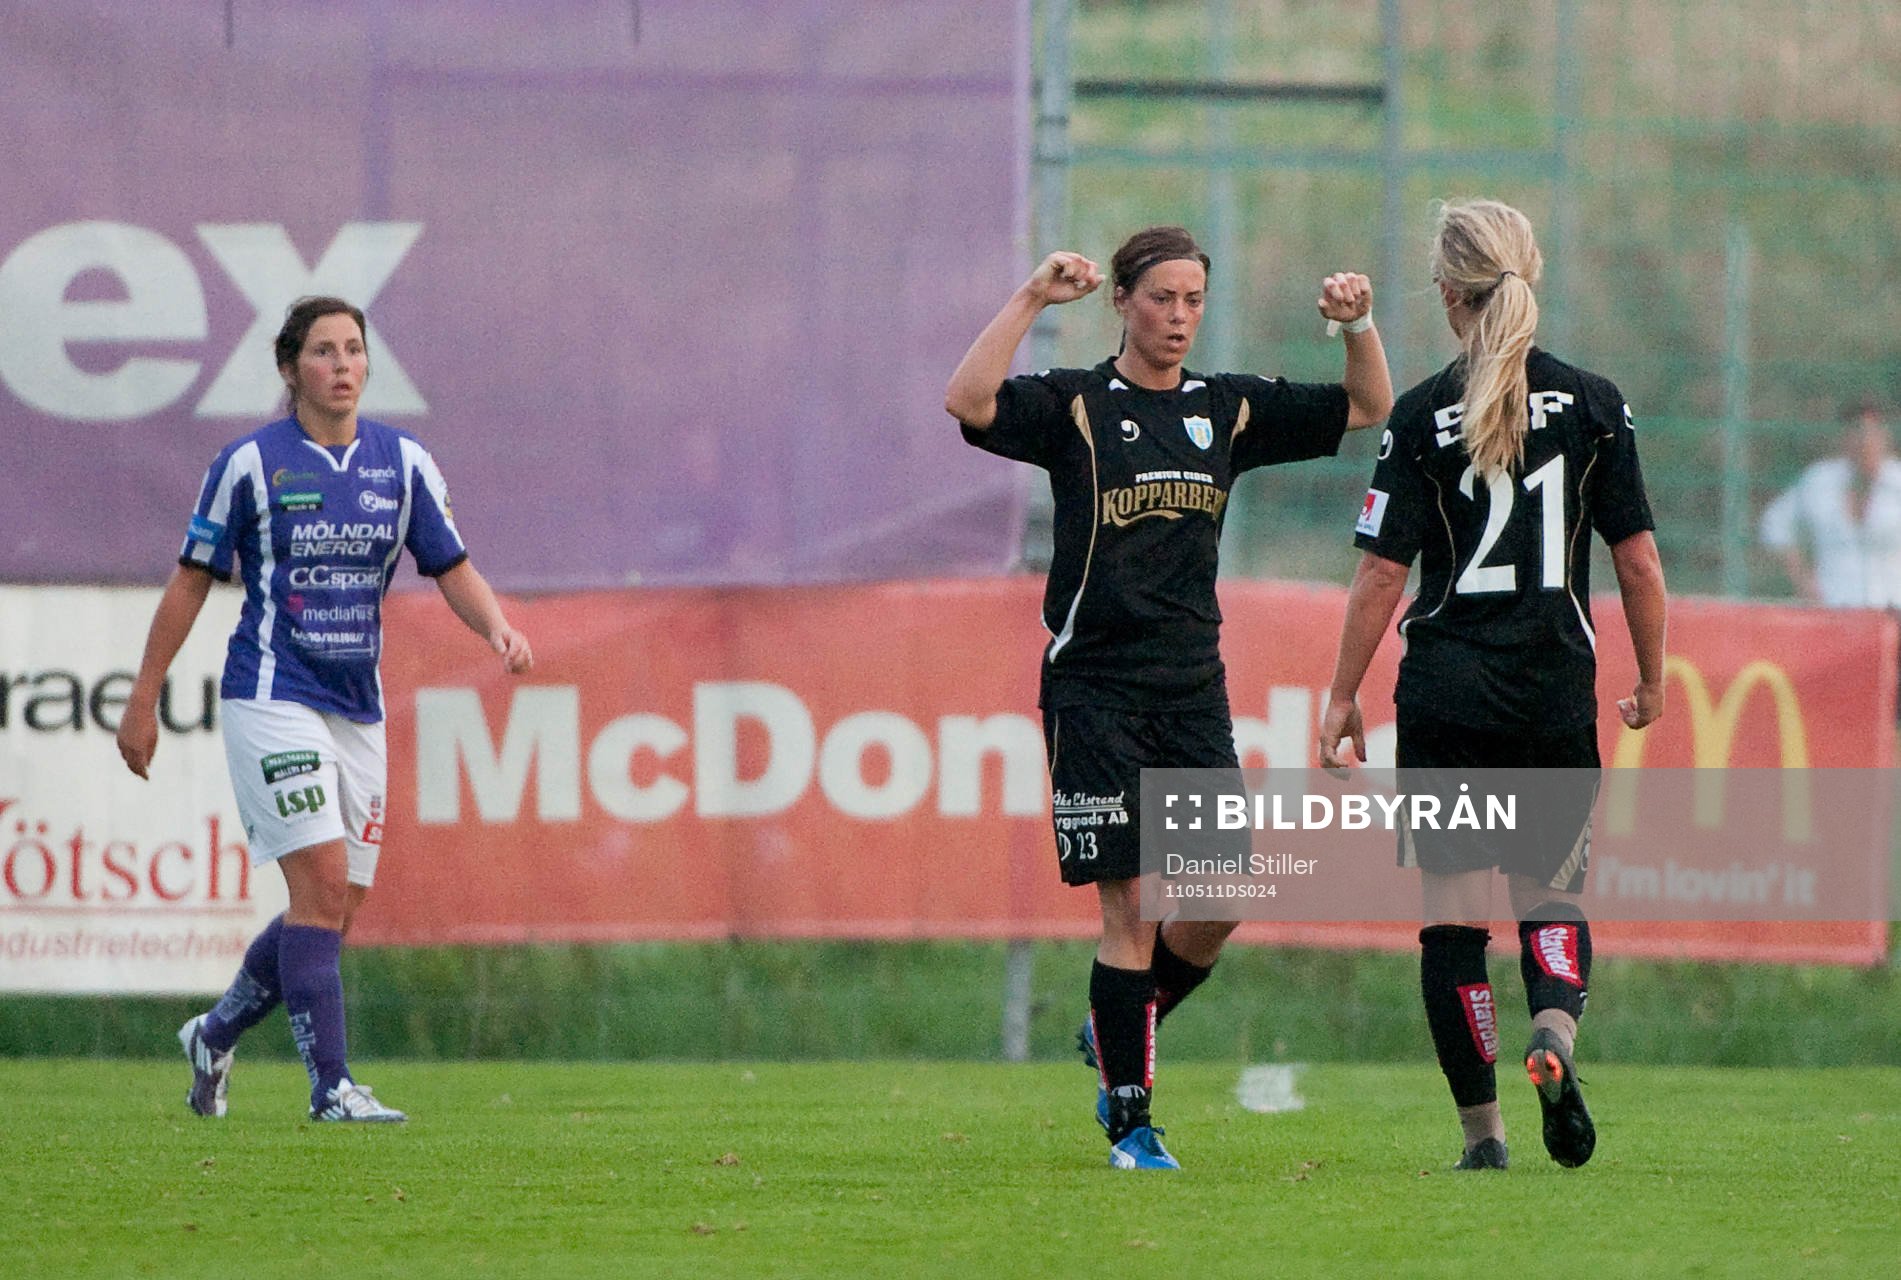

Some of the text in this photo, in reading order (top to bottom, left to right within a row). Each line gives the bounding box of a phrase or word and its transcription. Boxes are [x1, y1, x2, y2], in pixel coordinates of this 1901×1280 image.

[0, 220, 429, 422] ex
[1434, 390, 1575, 449] SF
[1135, 470, 1213, 484] PREMIUM CIDER
[290, 541, 372, 558] ENERGI
[291, 519, 395, 540] MÖLNDAL
[1456, 453, 1570, 594] 21
[413, 680, 1398, 826] McDond
[274, 784, 326, 818] isp
[1107, 811, 1129, 825] AB
[0, 797, 250, 901] ötsch
[1076, 832, 1098, 860] 23
[1539, 927, 1579, 980] Stavdal
[1470, 990, 1498, 1056] Stavdal
